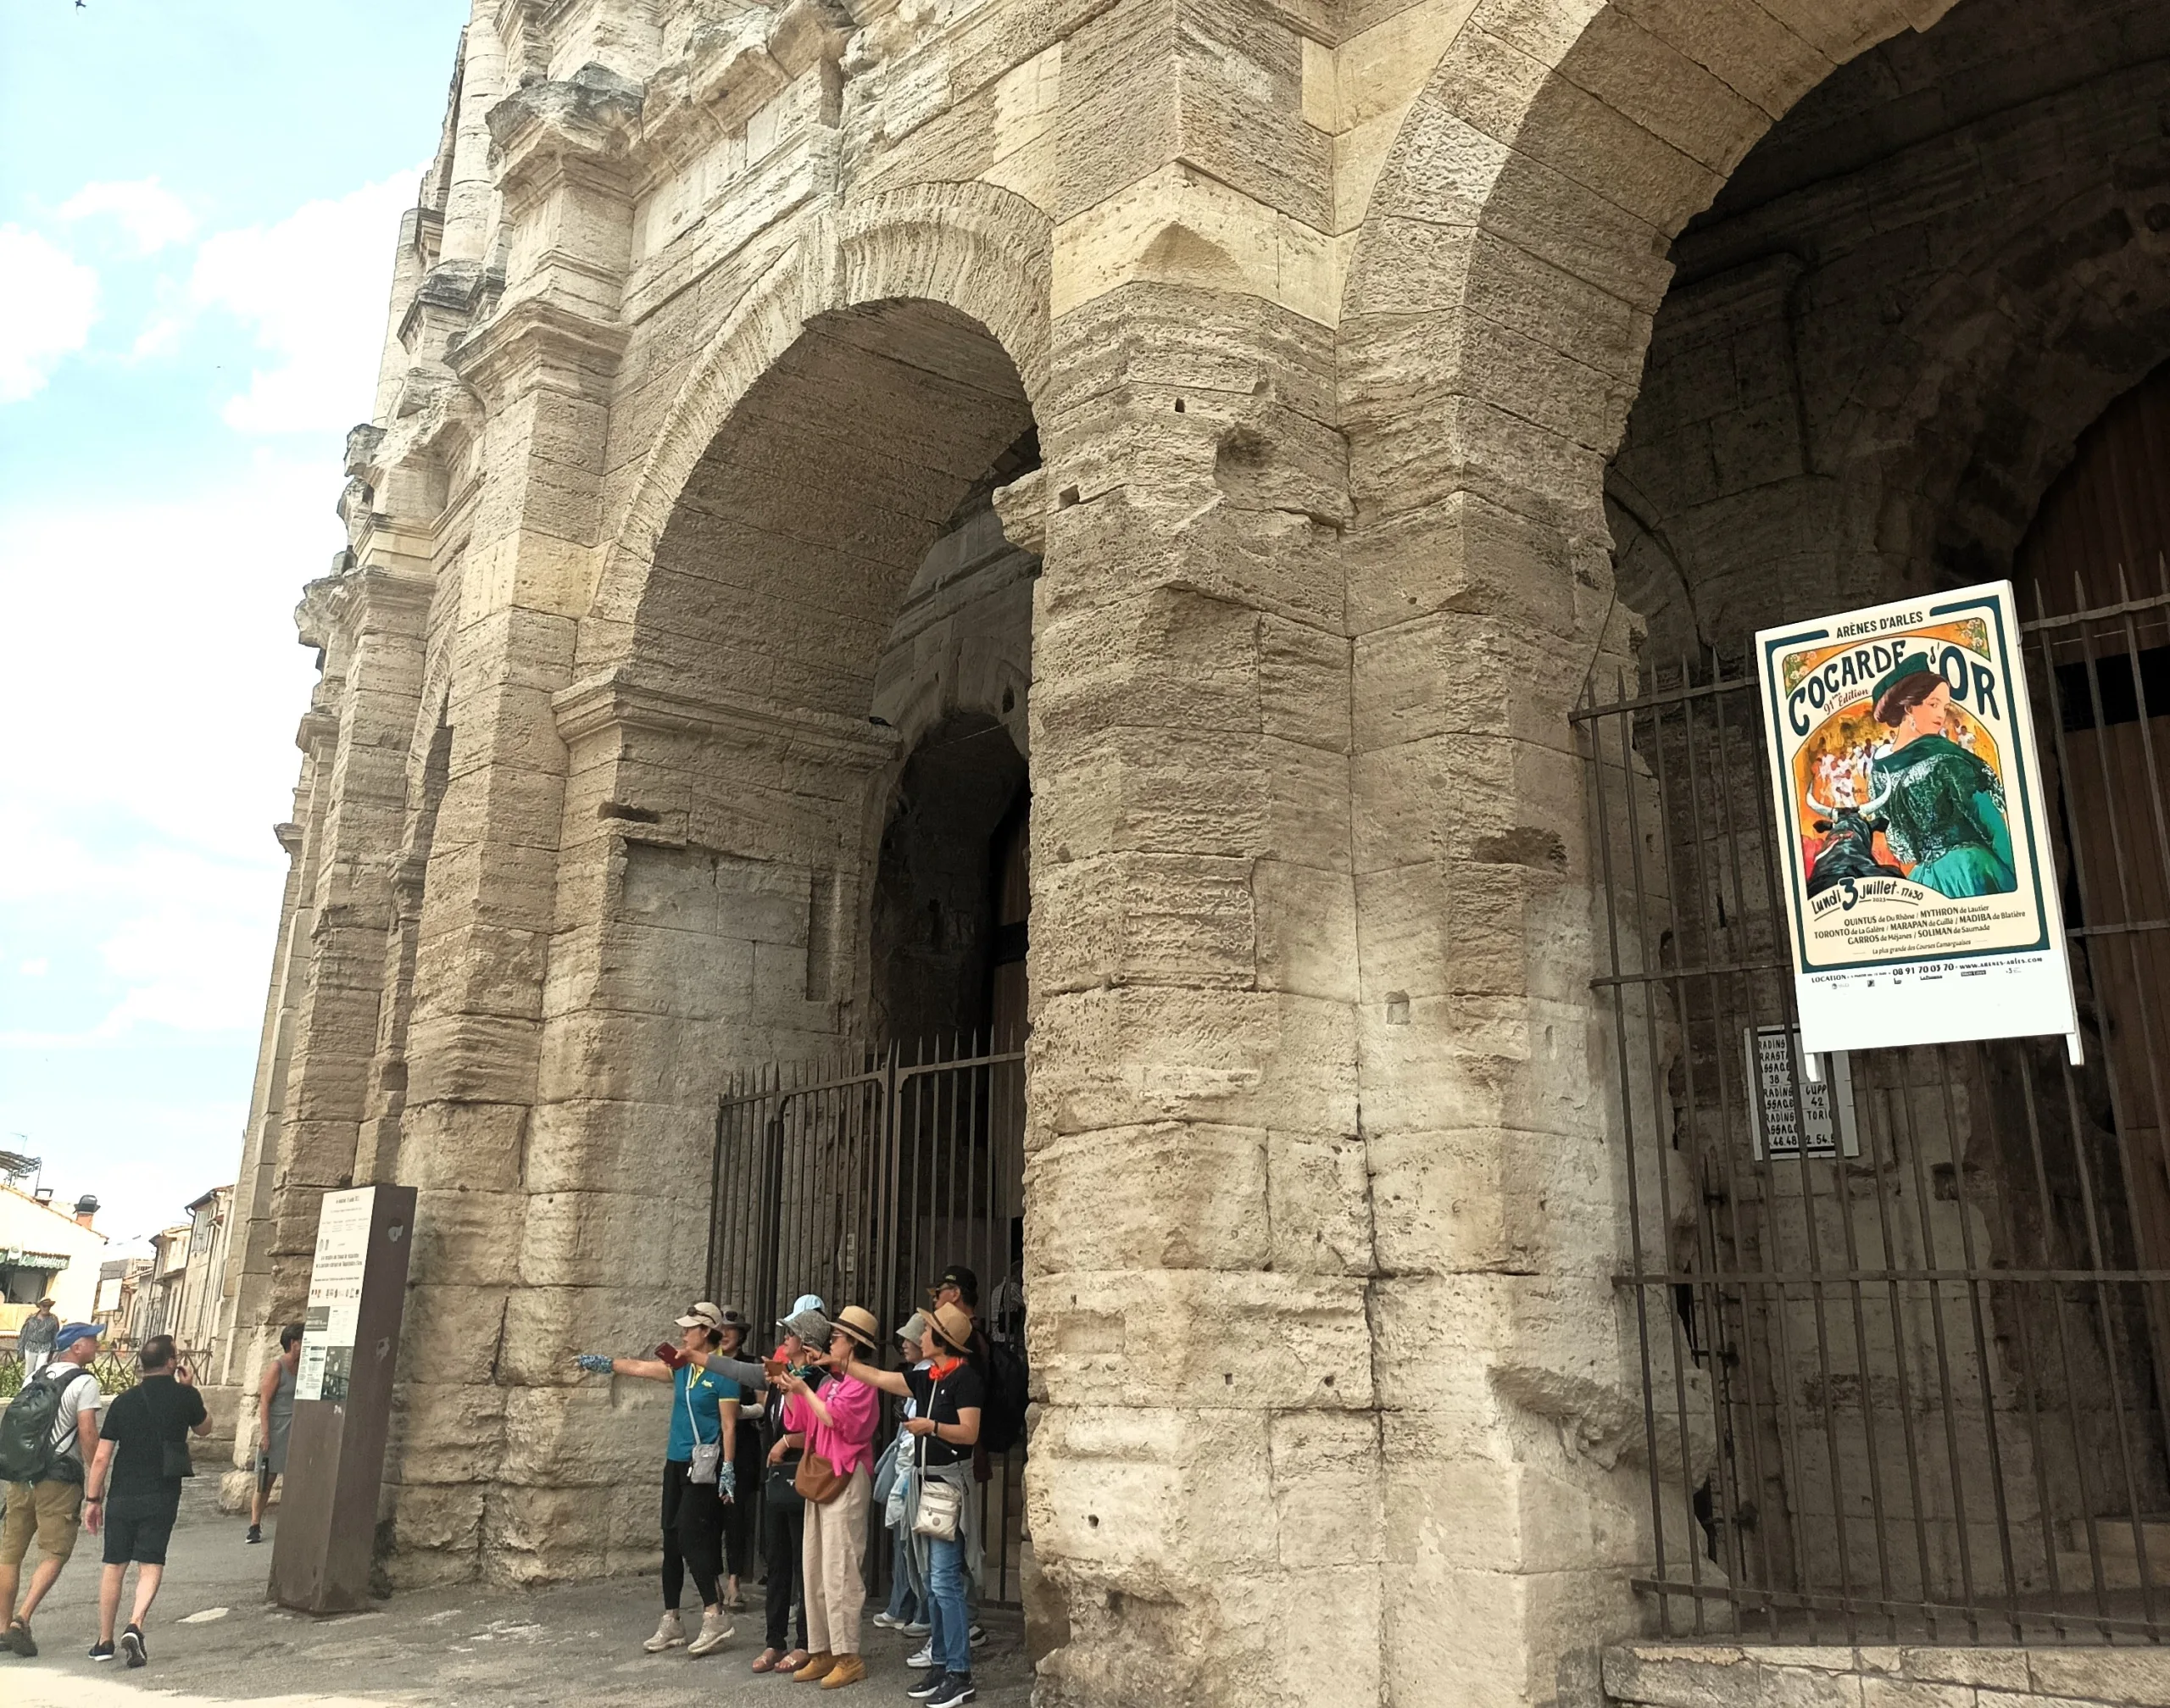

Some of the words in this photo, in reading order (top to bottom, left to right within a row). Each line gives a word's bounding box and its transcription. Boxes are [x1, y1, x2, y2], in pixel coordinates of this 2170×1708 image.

[1836, 620, 1878, 638] ARÈNES
[1879, 610, 1924, 631] D'ARLES
[1789, 640, 1906, 737] COCARDE
[1811, 889, 1841, 915] Lundi
[1839, 877, 1859, 911] 3
[1900, 887, 1924, 901] 17h30
[1814, 928, 1850, 939] TORONTO
[1889, 920, 1928, 931] MARAPAN
[1959, 913, 1992, 923] MADIBA
[2000, 910, 2026, 919] Blatière
[1844, 915, 1877, 926] QUINTUS
[1920, 907, 1959, 918] MYTHRON
[1967, 904, 1989, 913] Lautier
[1847, 934, 1880, 945] GARROS
[1917, 926, 1953, 937] SOLIMAN
[1961, 924, 1990, 933] Saumade
[1878, 947, 1889, 955] plus
[1889, 946, 1906, 954] grande
[1916, 942, 1936, 950] Courses
[1811, 974, 1847, 983] LOCATION
[1892, 968, 1904, 976] 08
[1905, 966, 1916, 975] 91
[1918, 965, 1929, 974] 70
[1943, 963, 1955, 971] 70
[1759, 1038, 1786, 1049] RADINS
